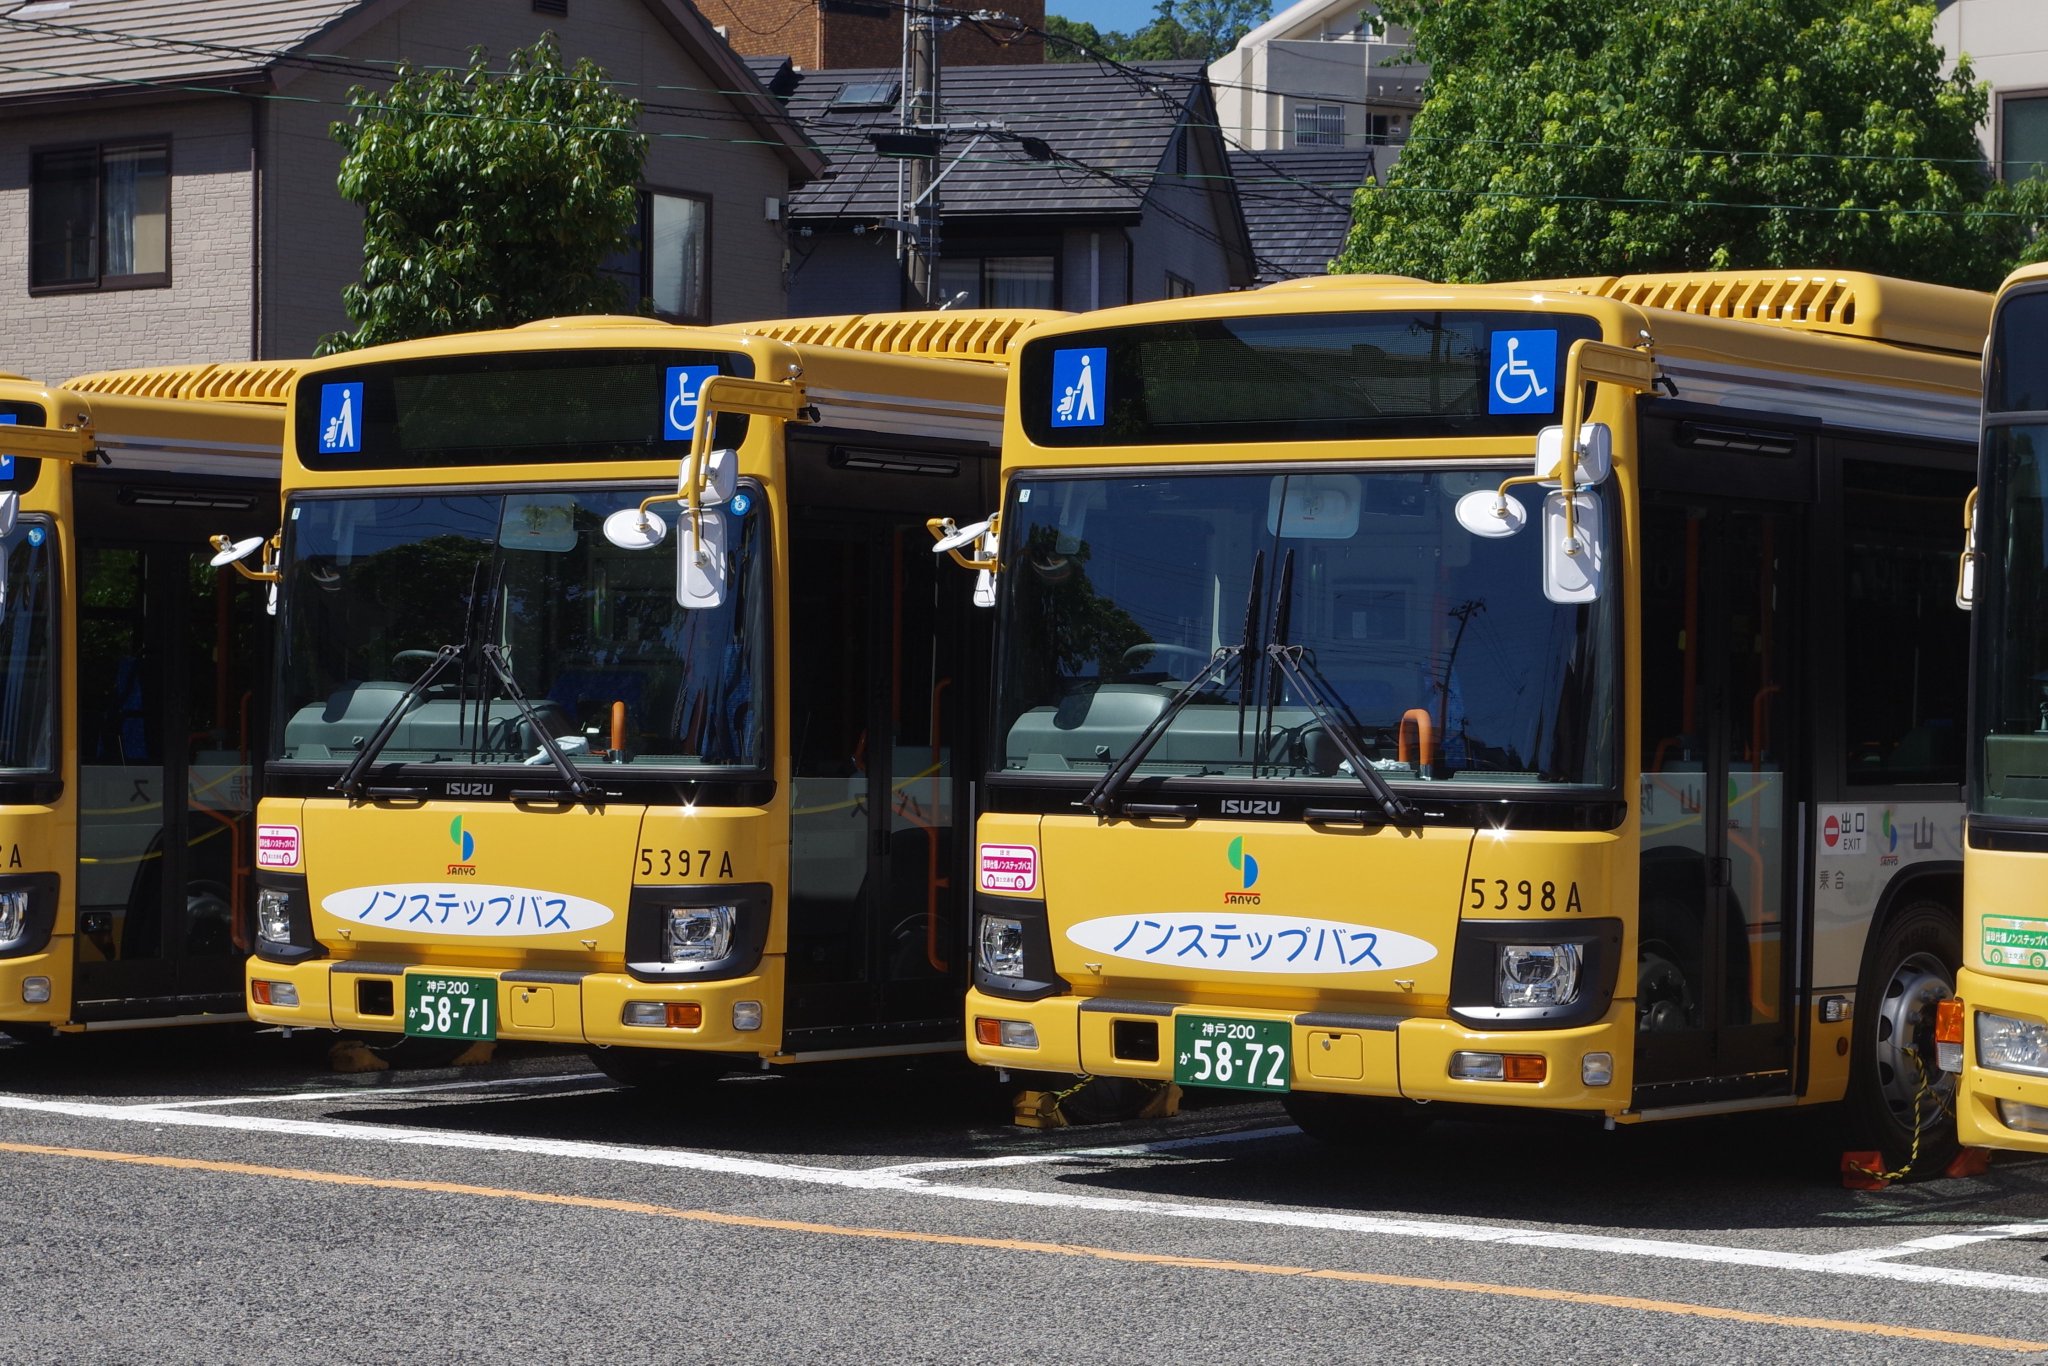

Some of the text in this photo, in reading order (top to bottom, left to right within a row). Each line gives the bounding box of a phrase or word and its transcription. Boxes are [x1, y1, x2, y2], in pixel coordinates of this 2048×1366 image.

[446, 782, 493, 796] ISUZU
[1221, 800, 1281, 815] ISUZU
[1841, 812, 1865, 834] 出口
[0, 844, 22, 868] A
[1843, 838, 1861, 850] EXIT
[446, 864, 476, 876] SANYO
[642, 848, 734, 878] 5397A
[1224, 892, 1261, 905] SANYO
[1471, 878, 1582, 912] 5398A
[359, 891, 571, 929] ノンステップバス
[1113, 920, 1383, 968] ノンステップバス
[409, 995, 488, 1035] か 58-71
[1179, 1039, 1285, 1086] か 58-72
